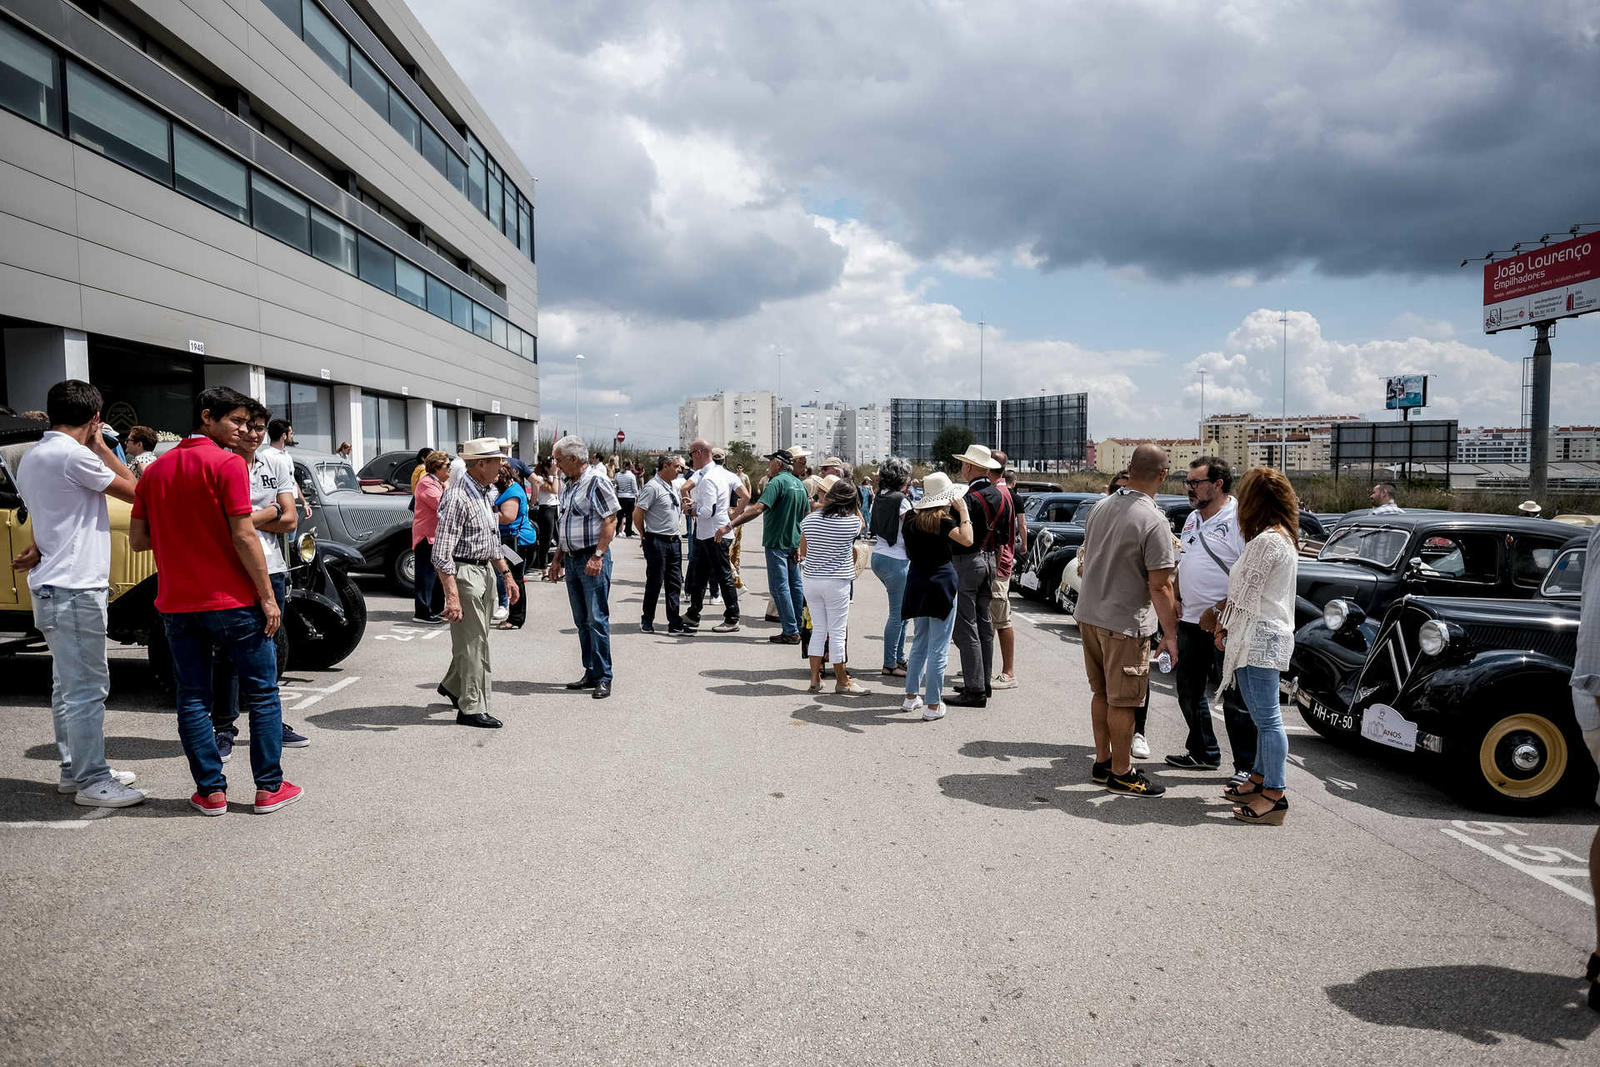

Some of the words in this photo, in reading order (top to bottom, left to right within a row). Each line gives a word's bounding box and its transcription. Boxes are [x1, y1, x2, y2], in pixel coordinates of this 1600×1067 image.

[1494, 261, 1525, 280] João
[1494, 270, 1546, 290] Empilhadores
[190, 342, 204, 352] 1948
[1313, 703, 1353, 729] HH-17-50
